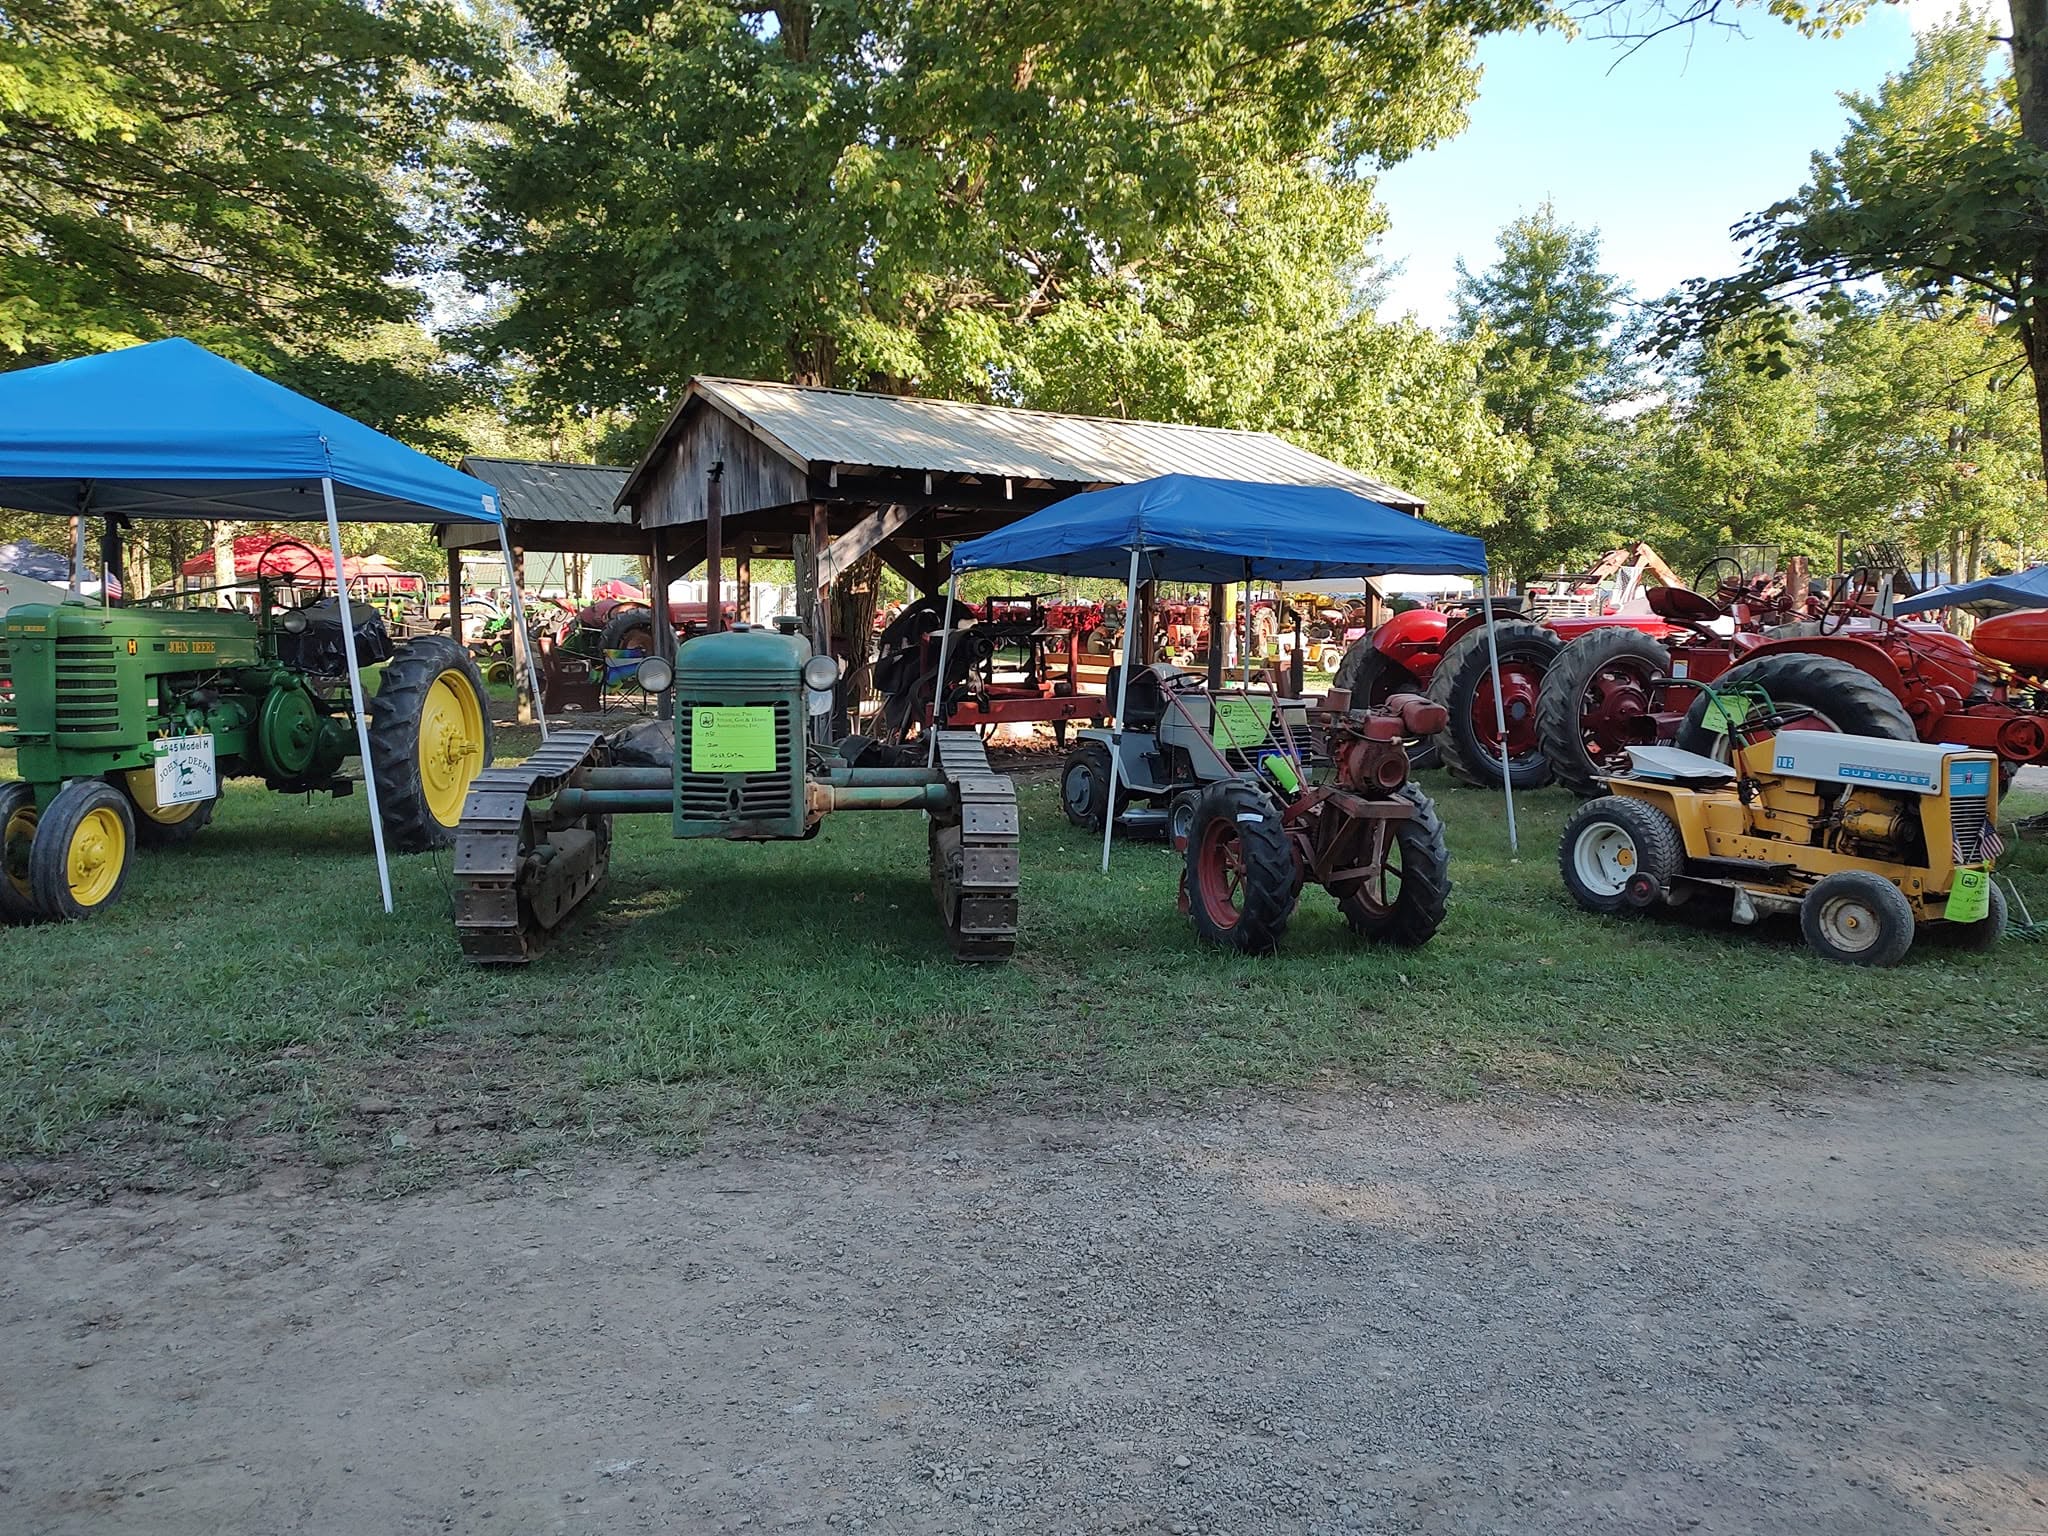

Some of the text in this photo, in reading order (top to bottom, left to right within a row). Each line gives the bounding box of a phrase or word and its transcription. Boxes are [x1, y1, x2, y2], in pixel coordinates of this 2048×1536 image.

[128, 640, 137, 653] H
[169, 641, 216, 653] JOHN DEERE
[180, 741, 202, 751] Model
[203, 740, 209, 748] H
[160, 756, 212, 782] JOHN DEERE
[1841, 768, 1872, 778] CUB
[1877, 773, 1929, 784] CADET
